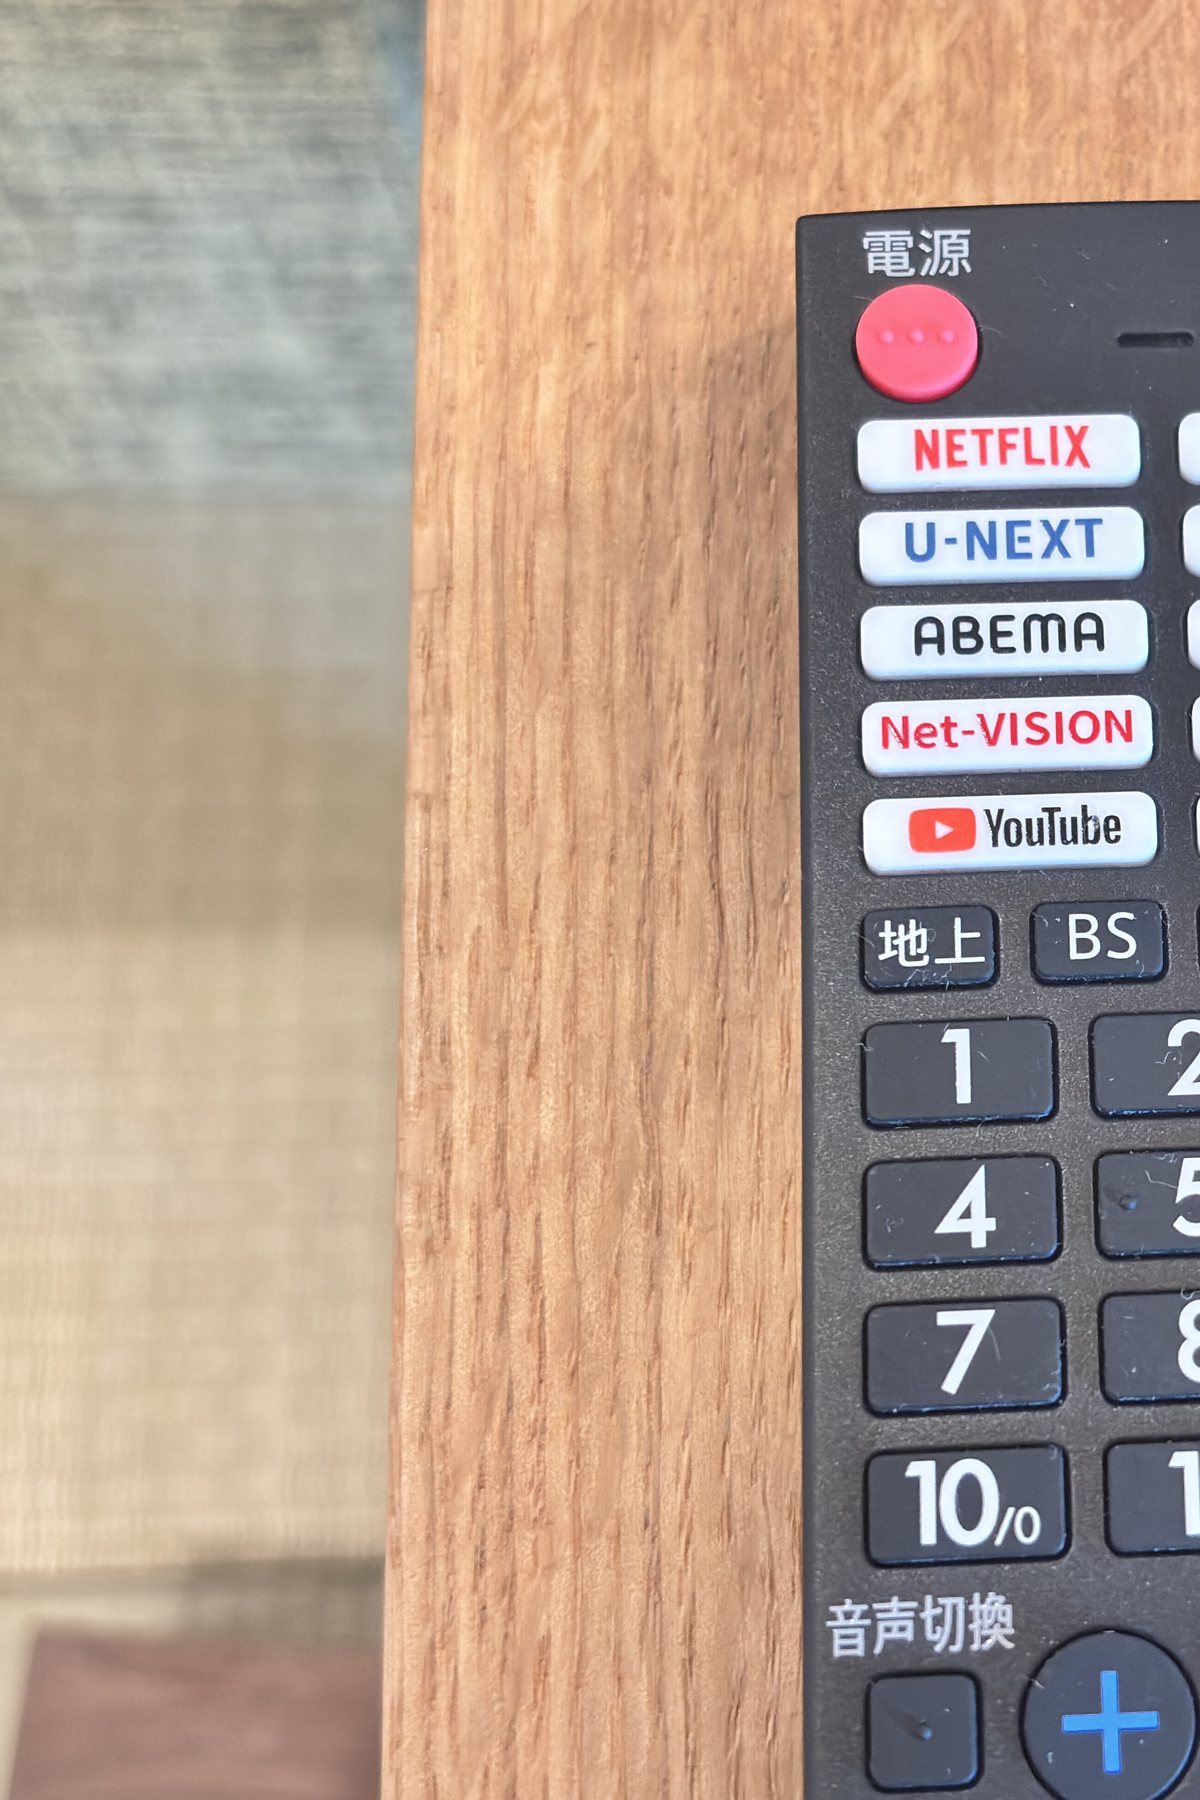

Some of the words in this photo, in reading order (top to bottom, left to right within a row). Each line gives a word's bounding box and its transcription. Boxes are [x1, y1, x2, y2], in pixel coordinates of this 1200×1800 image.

[862, 229, 972, 277] 電源
[914, 425, 1091, 471] NETFLIX
[905, 519, 1102, 562] U-NEXT
[914, 612, 1105, 657] ABEMA
[881, 710, 1134, 751] Net-VISION
[985, 806, 1122, 849] YouTube
[878, 920, 987, 966] 地上
[1068, 912, 1137, 961] BS
[940, 1028, 972, 1105] 1
[934, 1164, 997, 1249] 4
[935, 1309, 996, 1396] 7
[825, 1591, 1015, 1658] 音声切換
